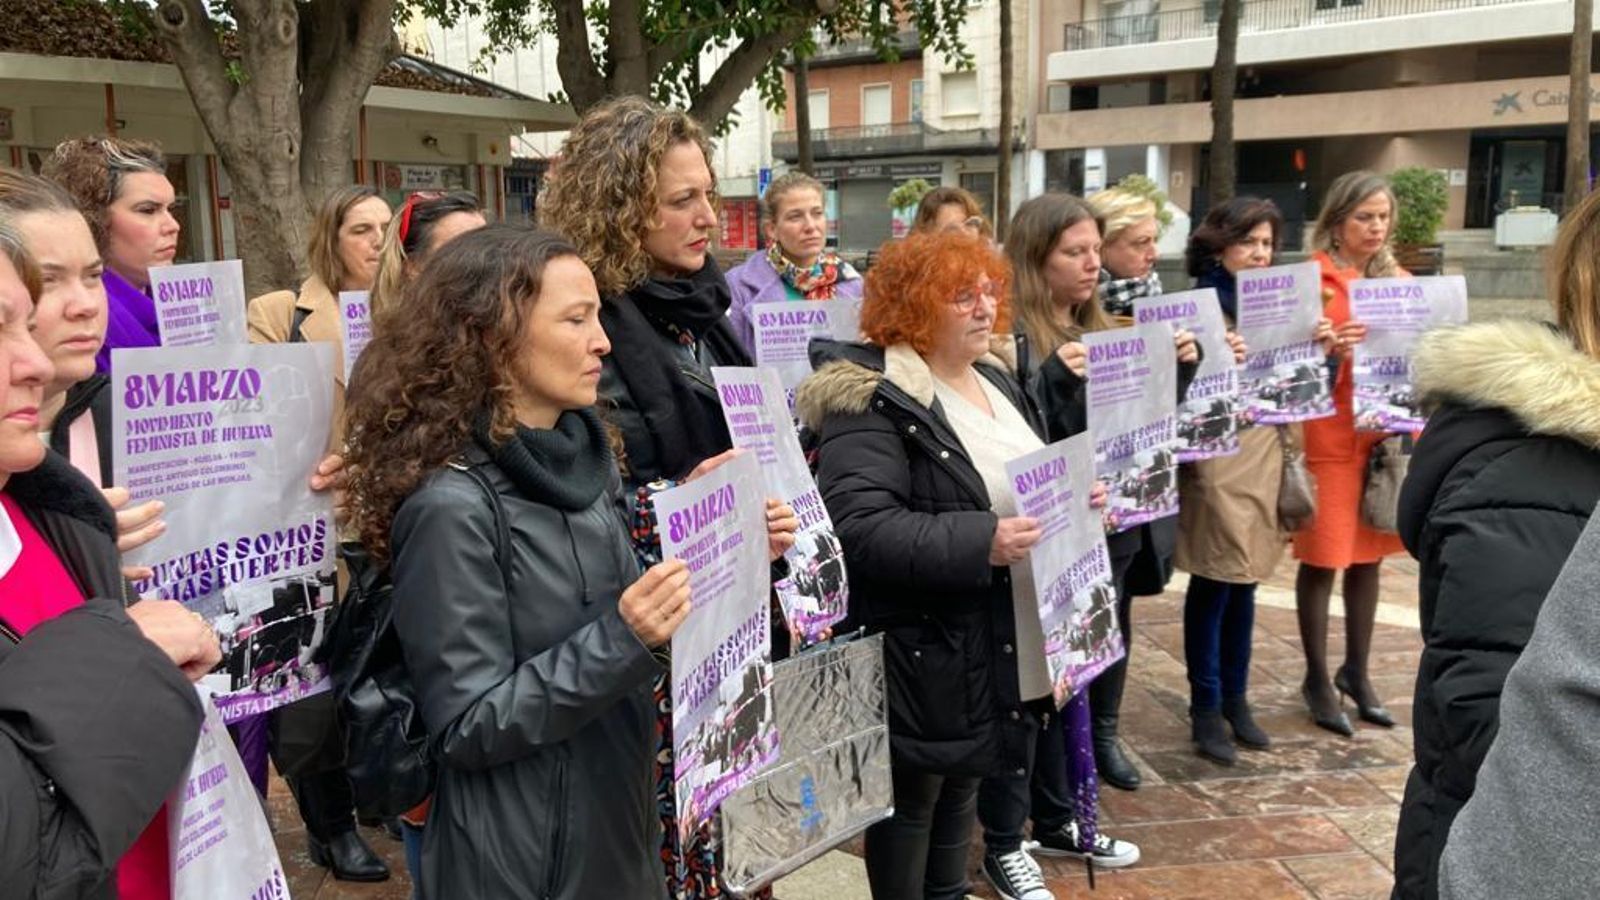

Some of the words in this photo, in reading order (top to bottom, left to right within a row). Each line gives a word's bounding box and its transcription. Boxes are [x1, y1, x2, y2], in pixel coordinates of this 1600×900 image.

[159, 277, 213, 303] 8MARZO
[760, 310, 827, 327] 8MARZO
[1139, 301, 1197, 323] 8MARZO
[1089, 337, 1146, 363] 8MARZO
[124, 368, 261, 409] 8MARZO
[721, 383, 763, 407] 8MARZO
[126, 411, 213, 436] MOVIMIENTO
[127, 431, 197, 455] FEMINISTA
[202, 428, 218, 444] DE
[222, 424, 273, 442] HUELVA
[1015, 456, 1066, 495] 8MARZO
[668, 483, 735, 544] 8MARZO
[787, 490, 819, 514] OMOS
[798, 506, 825, 531] ERTES
[235, 519, 326, 560] SOMOS
[217, 541, 325, 589] FUERTES
[221, 699, 261, 720] NISTA
